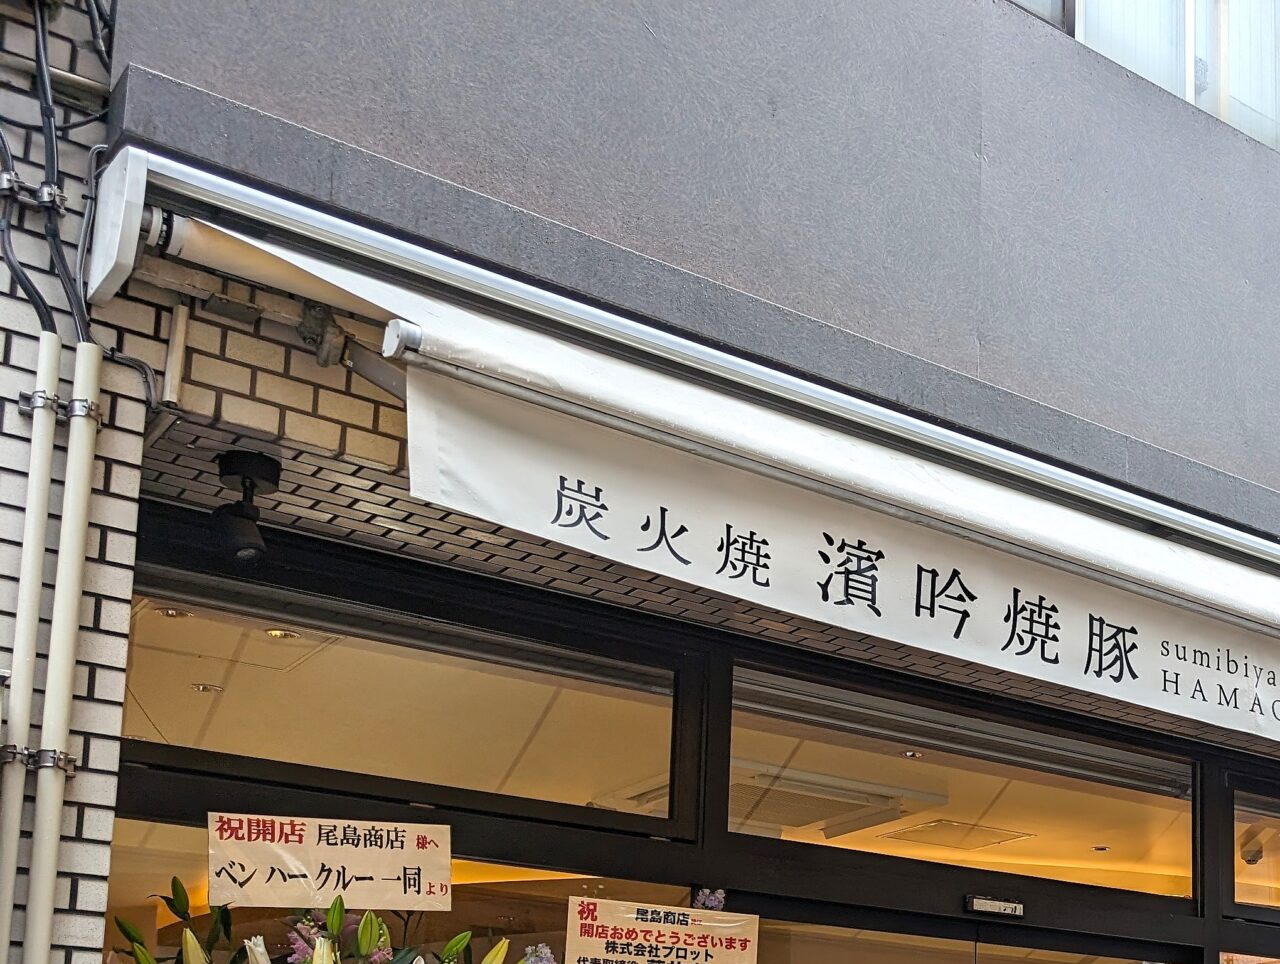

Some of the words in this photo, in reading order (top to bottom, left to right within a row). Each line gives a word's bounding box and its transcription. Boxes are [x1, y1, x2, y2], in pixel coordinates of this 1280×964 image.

[550, 475, 772, 588] 炭火焼
[817, 532, 1140, 683] 濱吟焼豚
[215, 815, 307, 845] 祝開店
[316, 823, 407, 850] 尾島商店
[415, 834, 439, 850] 様へ
[577, 900, 598, 922] 祝
[635, 908, 691, 926] 尾島商店
[579, 923, 751, 951] 開店おめでとうございます
[604, 940, 714, 962] 株式会社プロット
